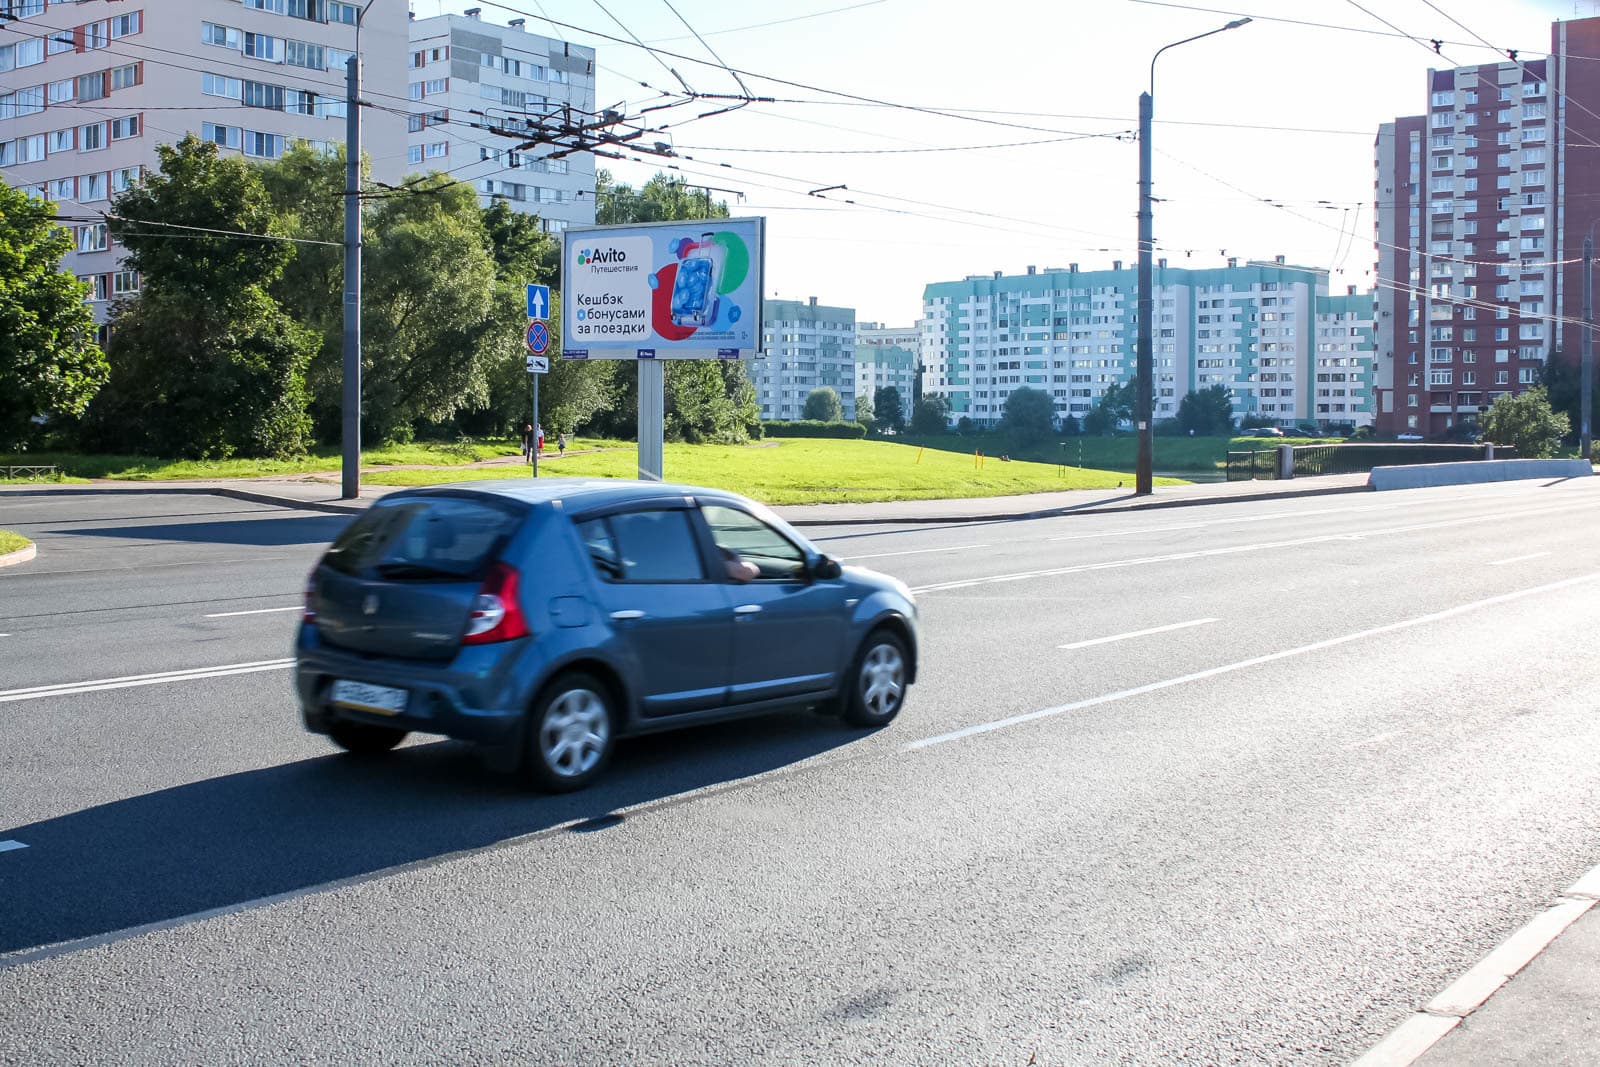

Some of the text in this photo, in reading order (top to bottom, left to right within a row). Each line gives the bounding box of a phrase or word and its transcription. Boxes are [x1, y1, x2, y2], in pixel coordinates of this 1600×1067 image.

[591, 248, 626, 263] Avito
[591, 265, 639, 275] Путешествия
[577, 293, 623, 305] Кешбэк
[587, 308, 645, 322] бонусами
[577, 324, 645, 335] за поездки
